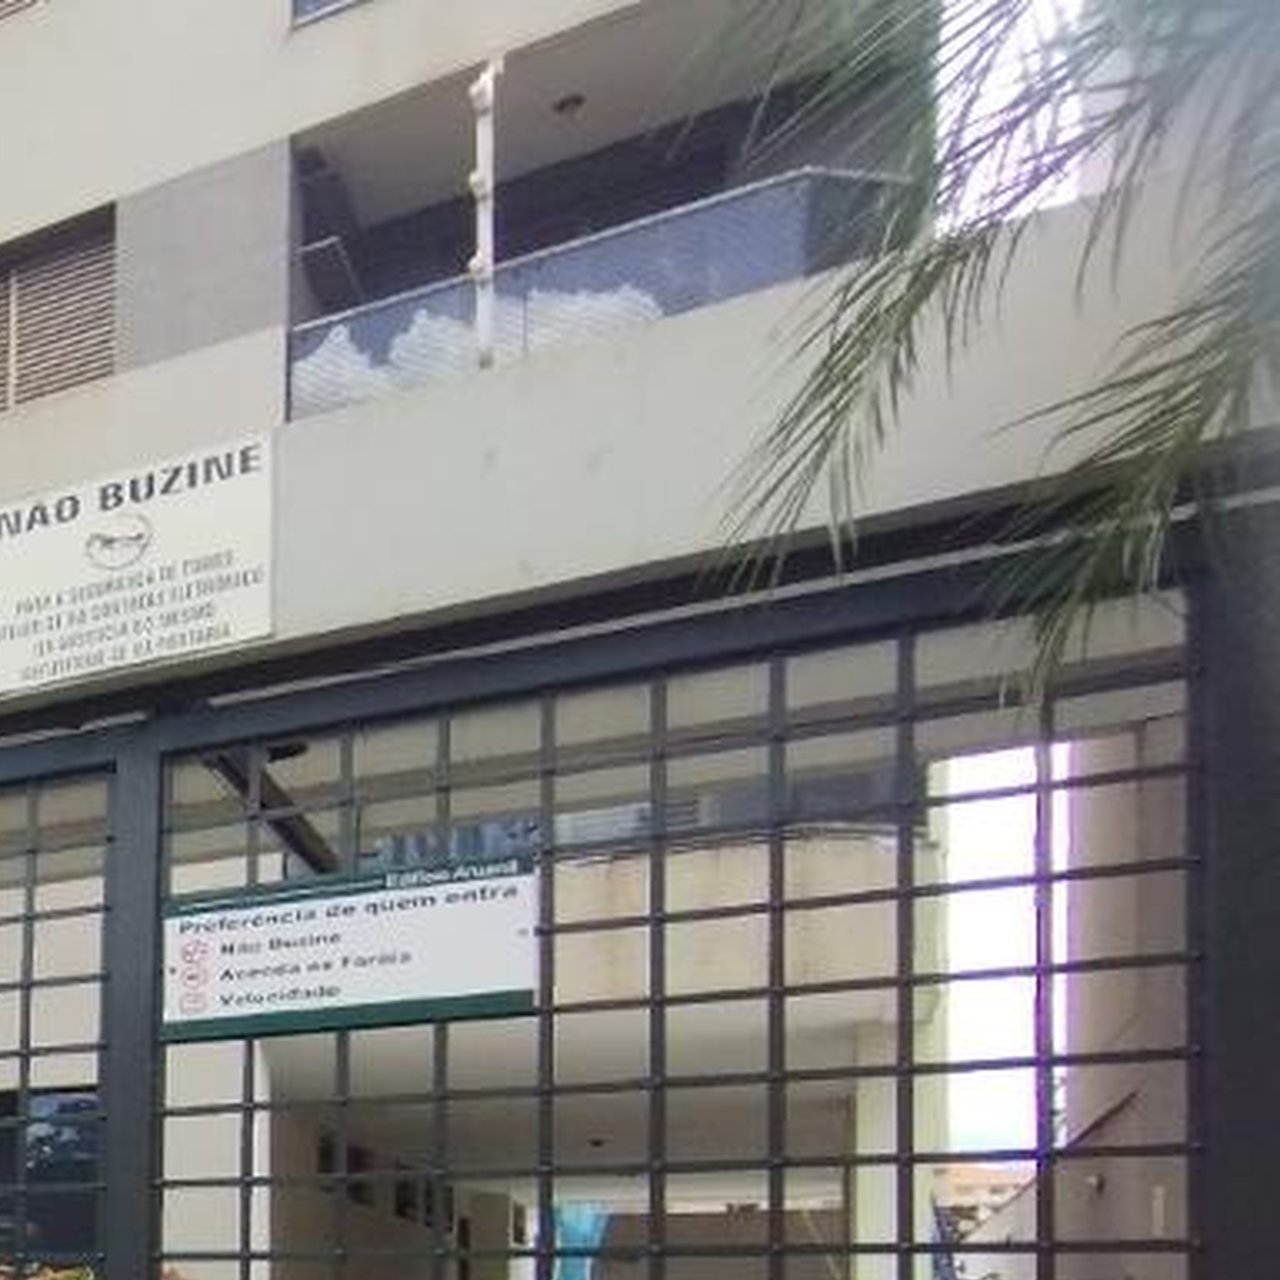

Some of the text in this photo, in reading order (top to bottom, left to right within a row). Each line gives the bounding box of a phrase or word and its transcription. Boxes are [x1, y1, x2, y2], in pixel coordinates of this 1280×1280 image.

[98, 444, 262, 512] BUZINE
[325, 905, 357, 919] de
[364, 895, 437, 916] quem
[444, 885, 518, 904] entra
